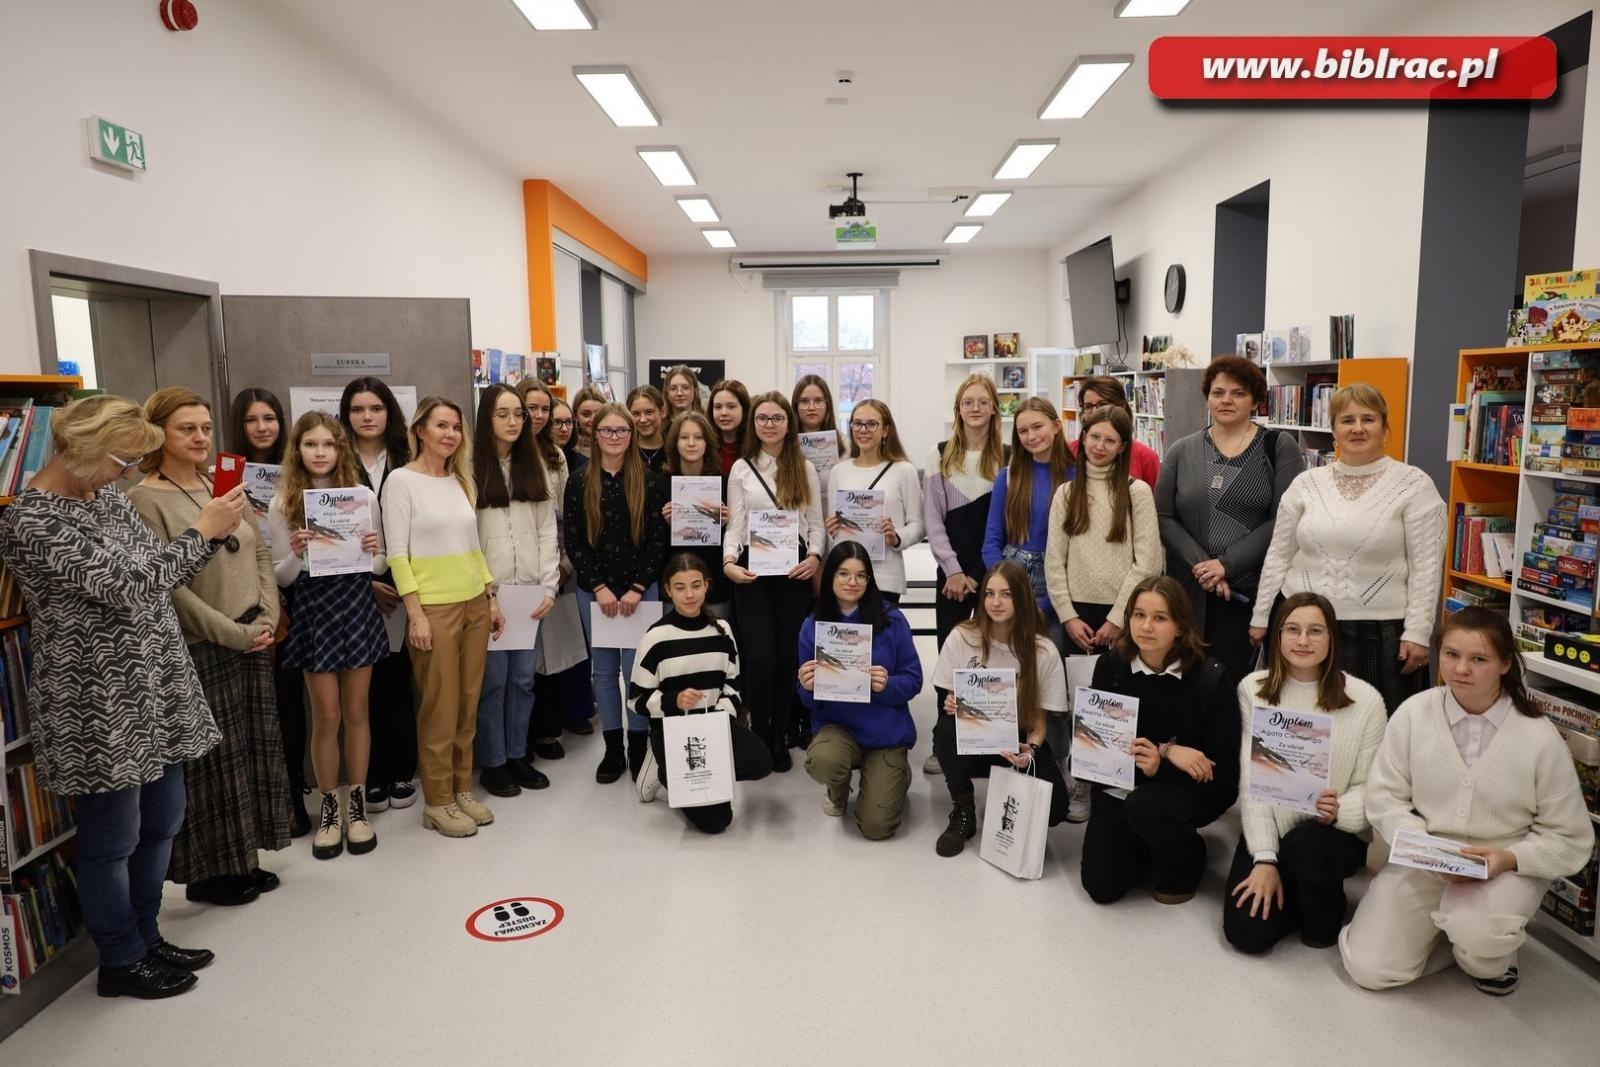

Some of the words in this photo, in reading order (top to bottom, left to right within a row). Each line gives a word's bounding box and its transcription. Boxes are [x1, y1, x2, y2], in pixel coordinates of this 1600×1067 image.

[318, 493, 355, 507] Dyplom
[845, 491, 874, 505] Dyplom
[828, 625, 859, 639] Dyplom
[967, 673, 1002, 689] Dyplom
[1088, 692, 1123, 710] Dyplom
[1269, 711, 1314, 730] Dyplom
[1413, 859, 1466, 873] Dyplom
[494, 919, 547, 936] ZACHOWAJ
[1, 927, 13, 972] KOSMOS
